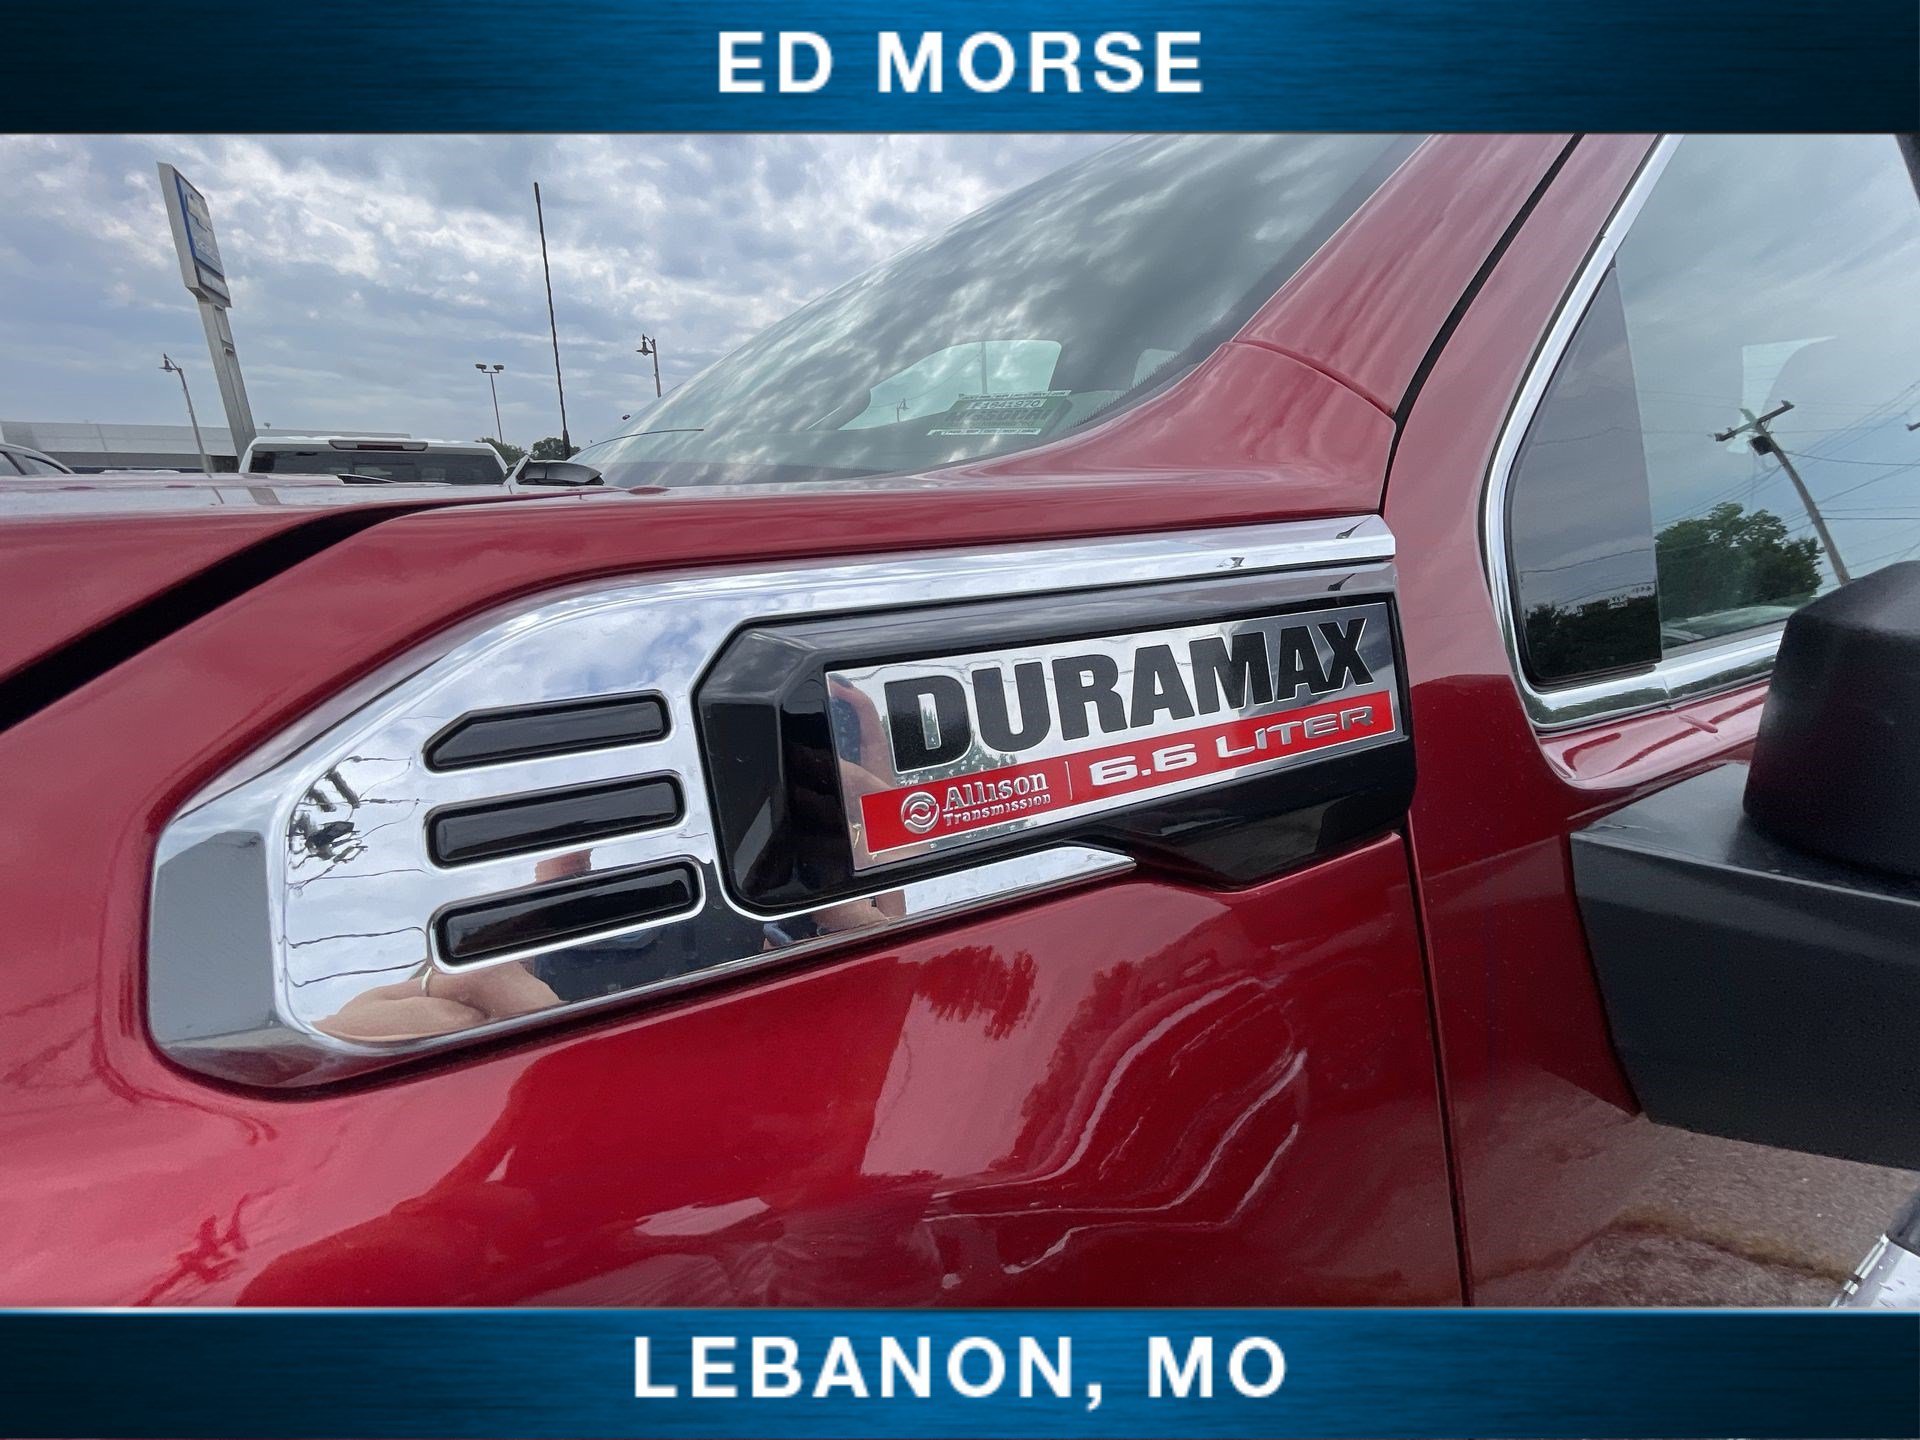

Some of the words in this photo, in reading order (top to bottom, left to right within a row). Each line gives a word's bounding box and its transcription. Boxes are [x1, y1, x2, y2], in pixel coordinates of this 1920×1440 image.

[884, 617, 1376, 774] DURAMAX
[1088, 742, 1198, 787] 6.6
[1215, 705, 1375, 759] LITER
[942, 772, 1050, 812] Allison
[942, 792, 1051, 827] Transmission
